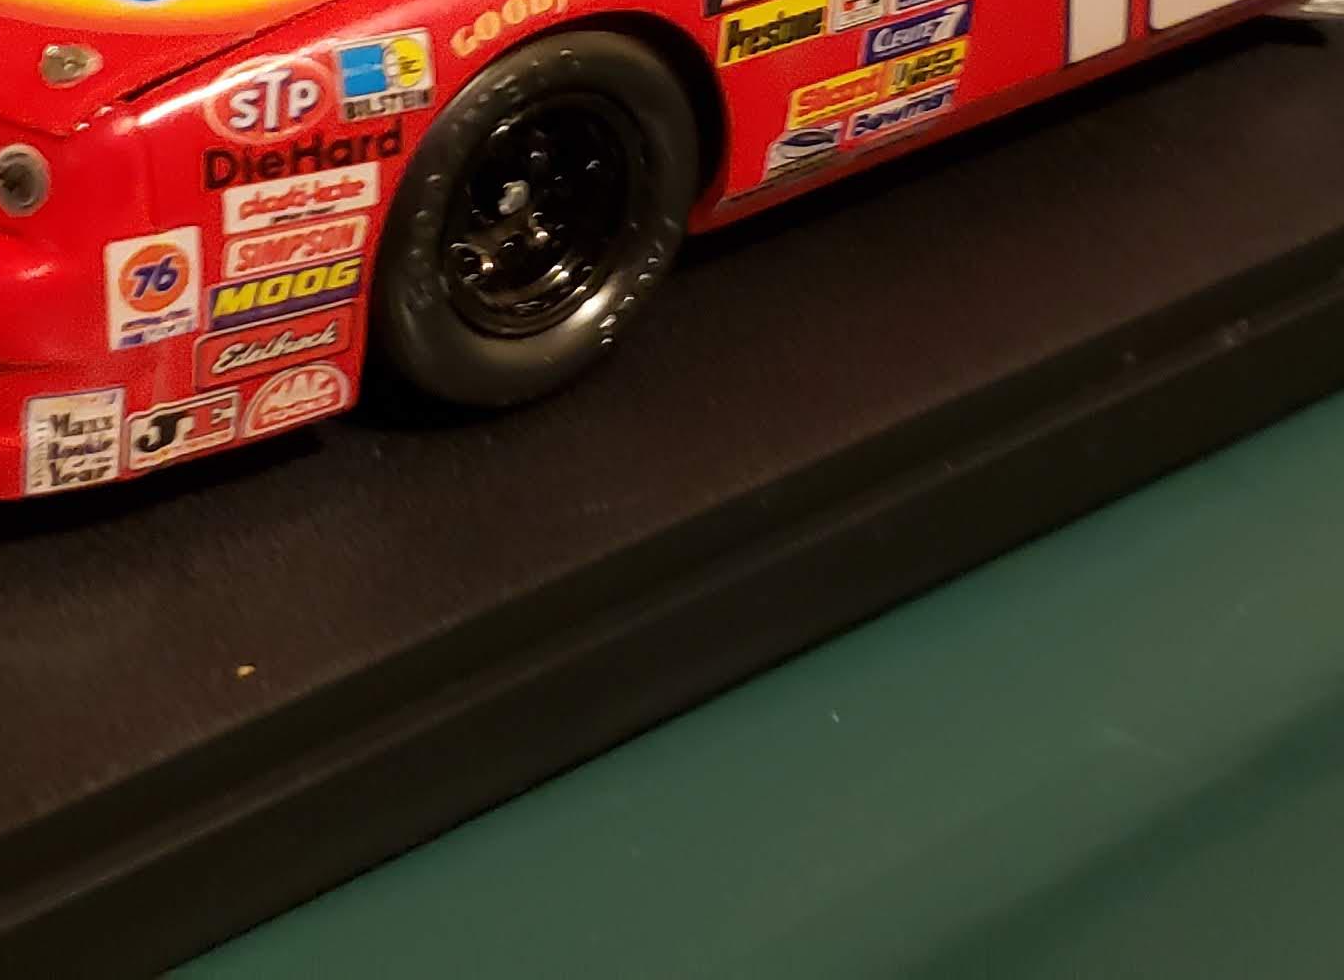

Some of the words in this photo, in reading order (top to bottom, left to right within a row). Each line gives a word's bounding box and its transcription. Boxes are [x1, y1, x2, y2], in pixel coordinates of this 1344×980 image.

[228, 68, 320, 131] STP
[345, 88, 432, 119] BILSTEIN
[202, 117, 404, 189] DieHard
[235, 221, 355, 271] SIMPSON
[132, 254, 180, 299] 76
[212, 257, 363, 317] MOOG
